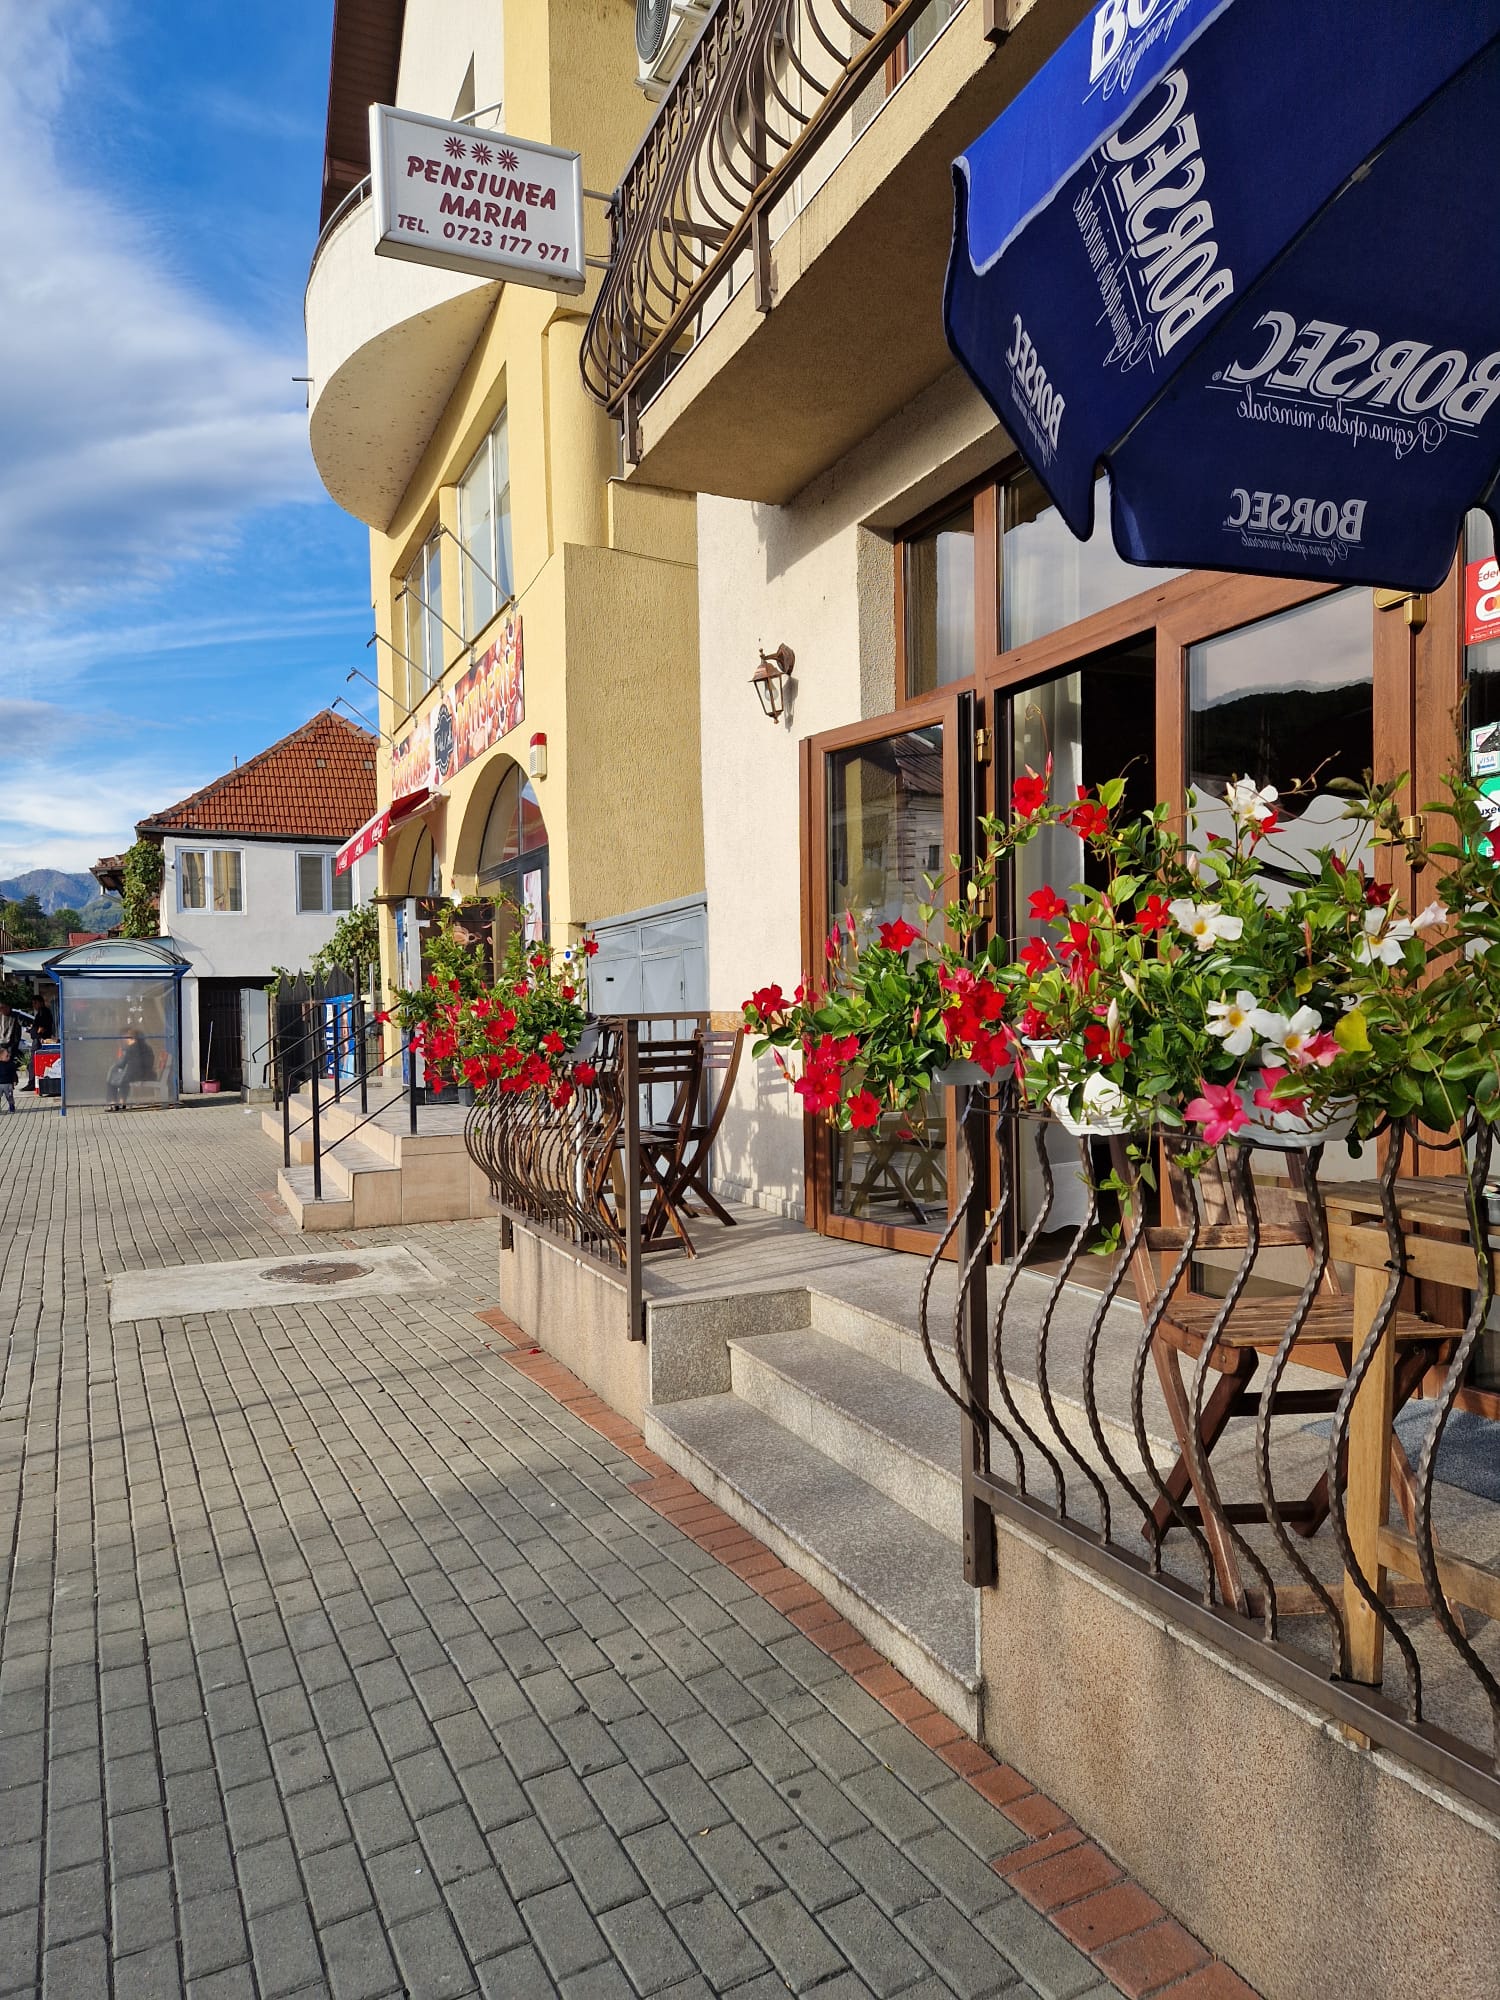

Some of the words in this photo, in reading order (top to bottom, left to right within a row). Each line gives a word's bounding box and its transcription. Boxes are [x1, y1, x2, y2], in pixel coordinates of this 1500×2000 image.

[407, 155, 557, 211] PENSIUNEA
[439, 193, 527, 232] MARIA
[397, 214, 430, 234] TEL.
[443, 222, 493, 247] 0723
[500, 235, 533, 255] 177
[537, 243, 570, 263] 971
[1479, 756, 1495, 764] VISA
